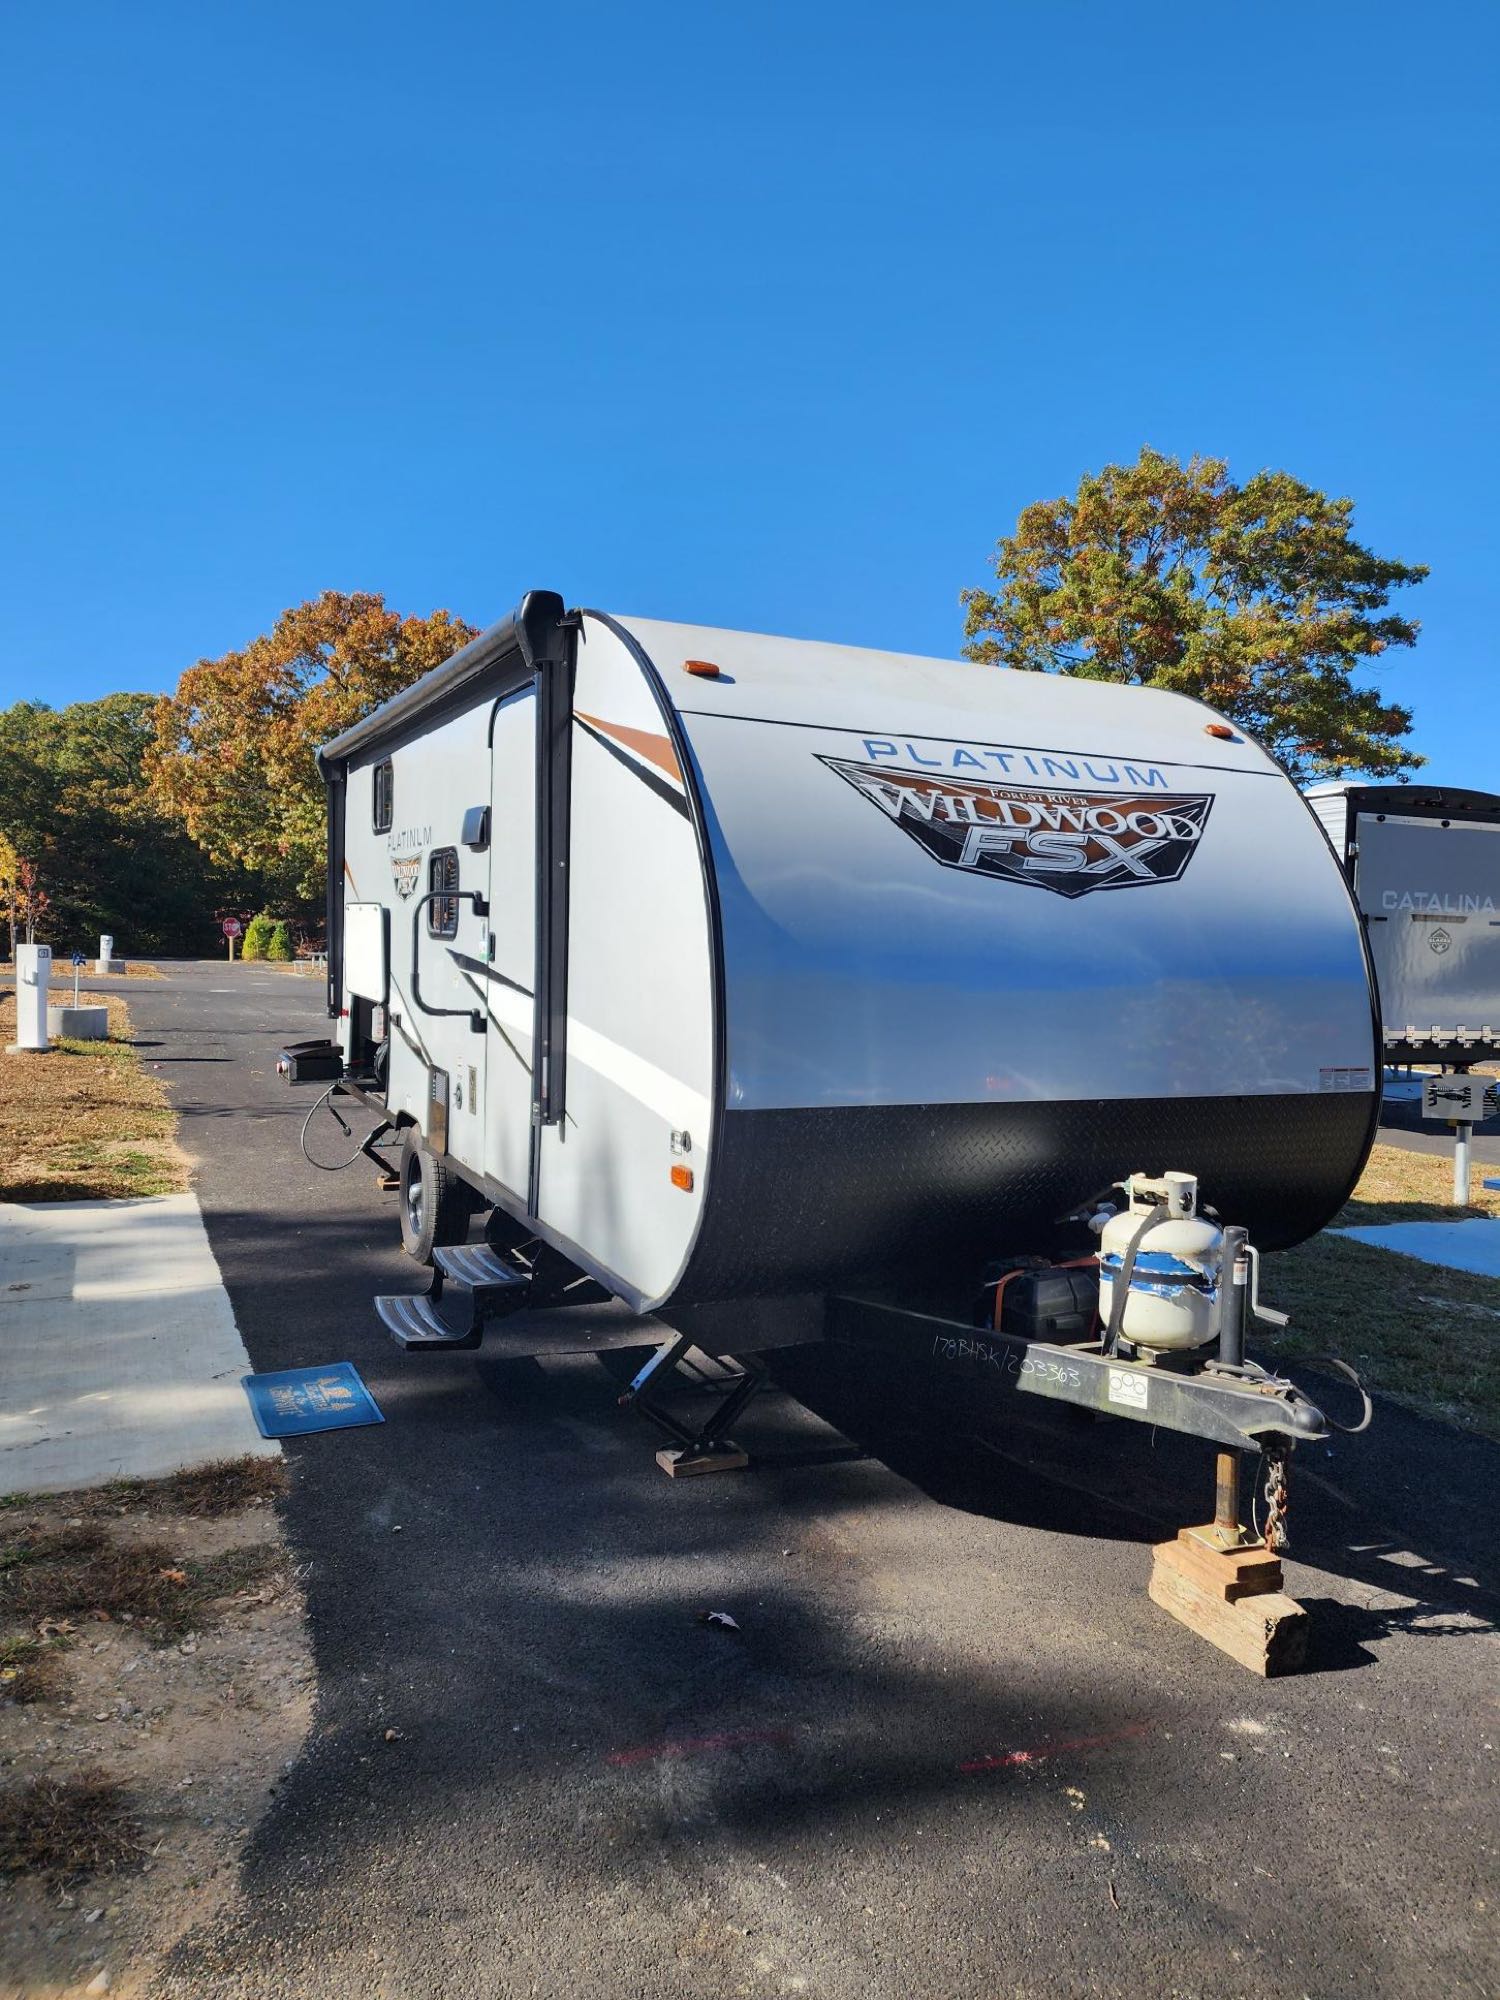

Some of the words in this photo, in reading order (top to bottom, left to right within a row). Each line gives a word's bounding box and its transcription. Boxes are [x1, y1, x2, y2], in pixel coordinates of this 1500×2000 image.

[861, 738, 1170, 789] PLATINUM
[862, 783, 1199, 840] WILDWOOD
[989, 788, 1044, 802] FOREST
[1045, 793, 1089, 807] RIVER
[960, 825, 1169, 879] FSX
[1382, 890, 1496, 914] CATALINA
